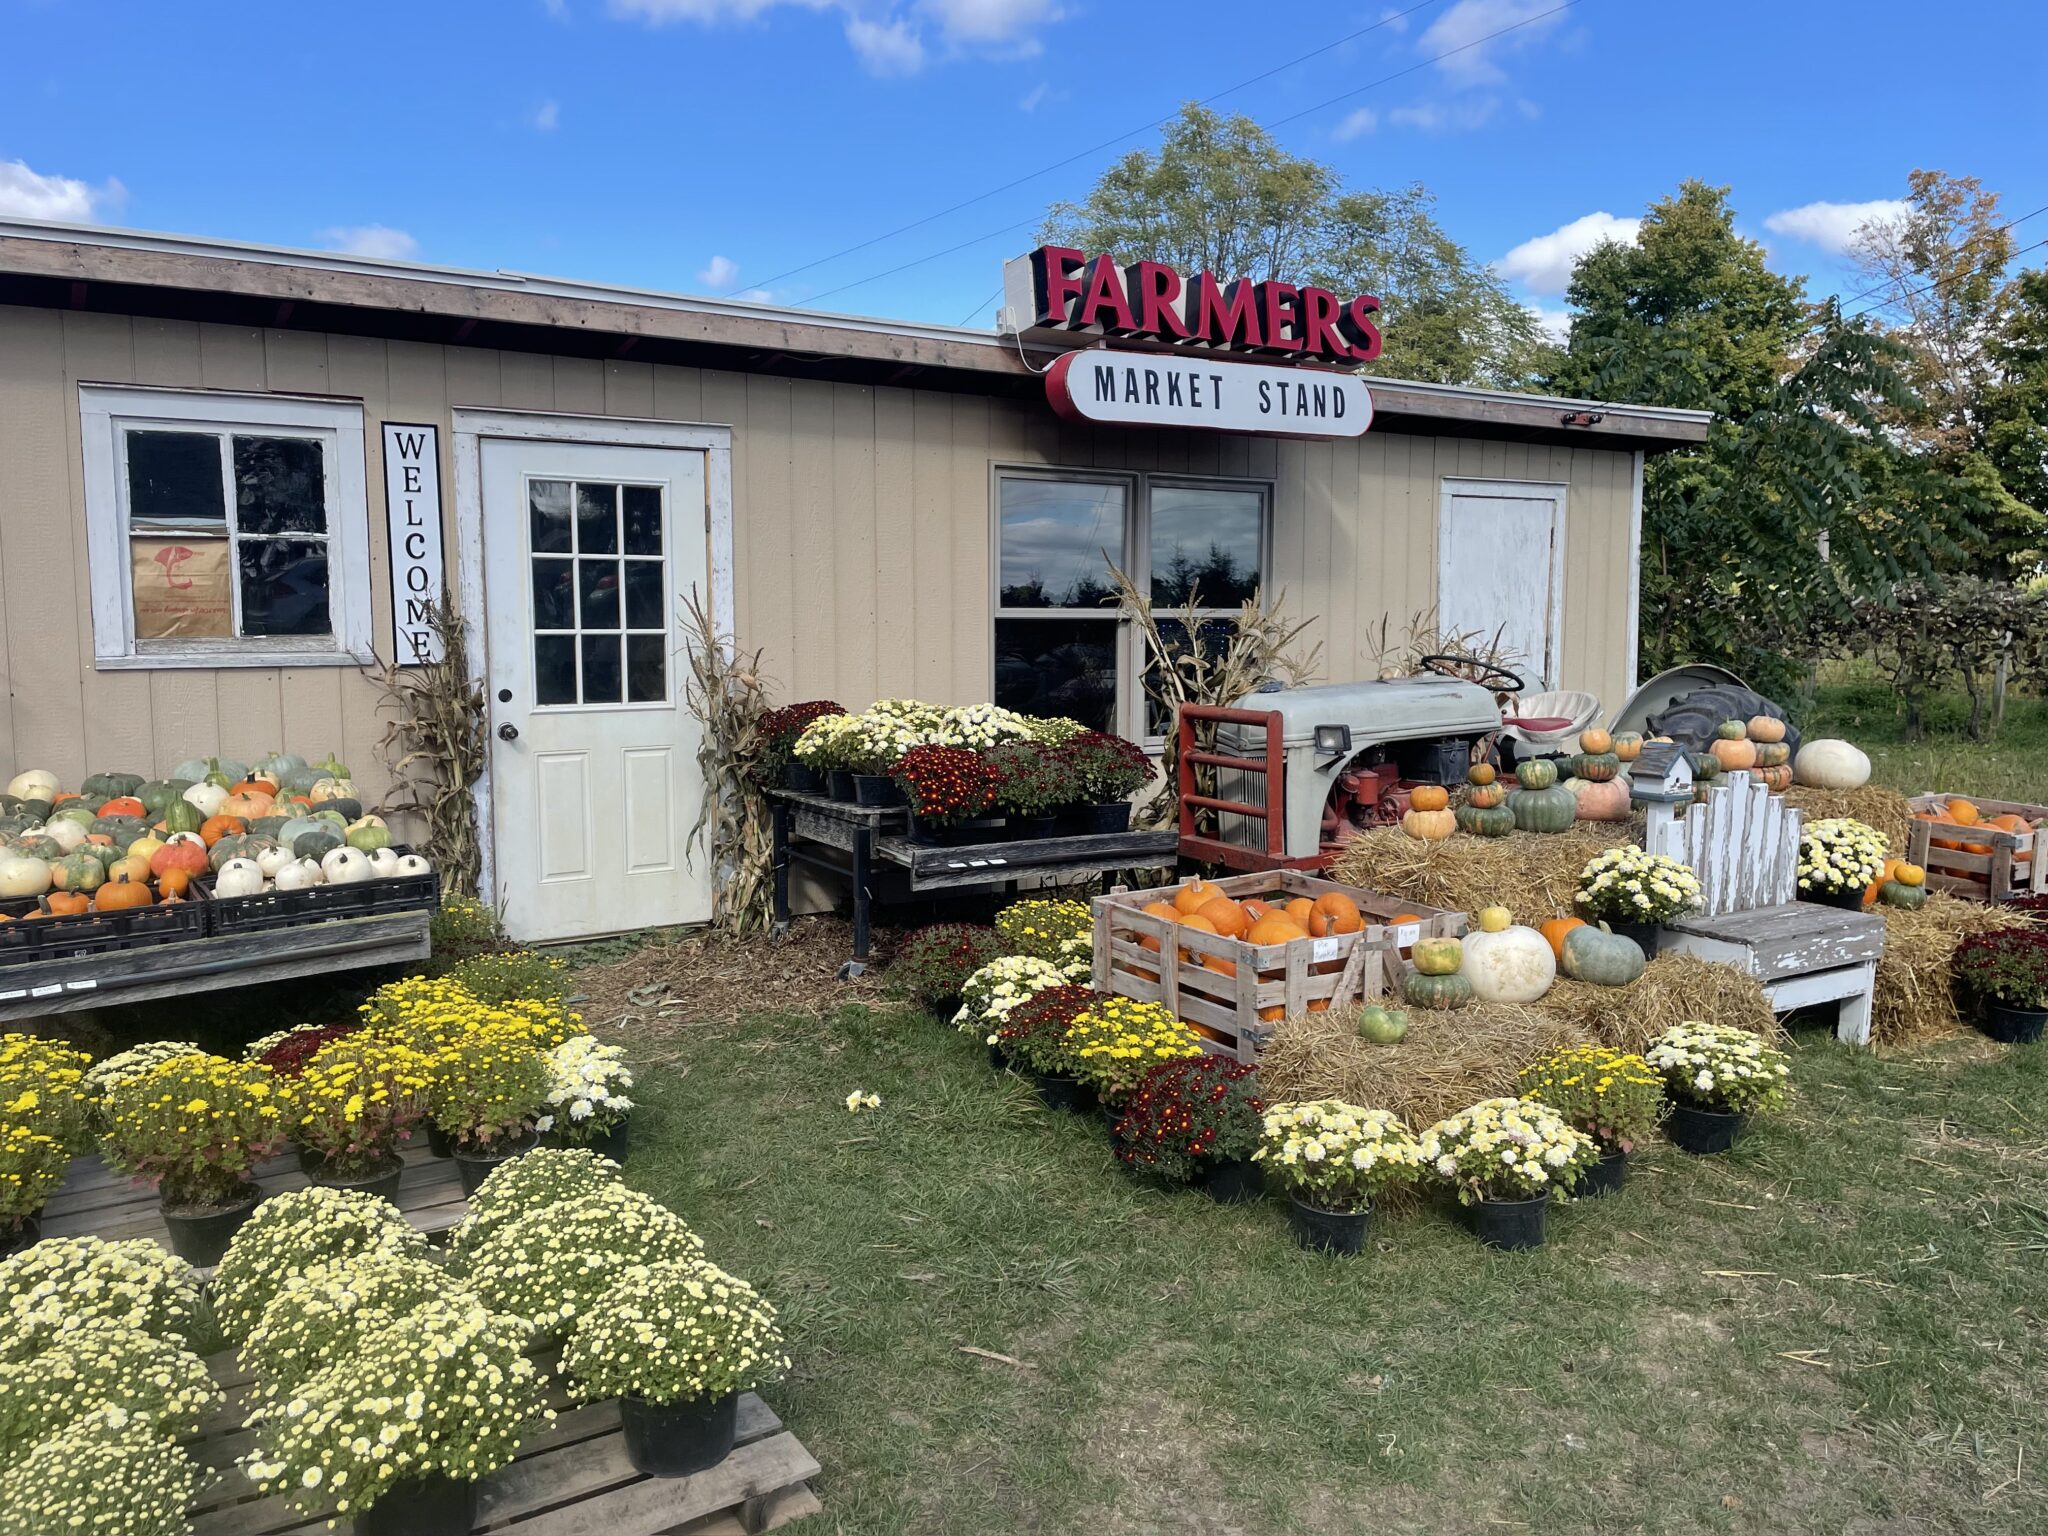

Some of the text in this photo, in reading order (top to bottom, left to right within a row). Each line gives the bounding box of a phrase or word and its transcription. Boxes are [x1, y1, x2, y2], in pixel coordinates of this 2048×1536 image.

[1042, 244, 1382, 362] FARMERS
[1094, 365, 1346, 419] MARKET STAND
[394, 432, 432, 658] WELCOME
